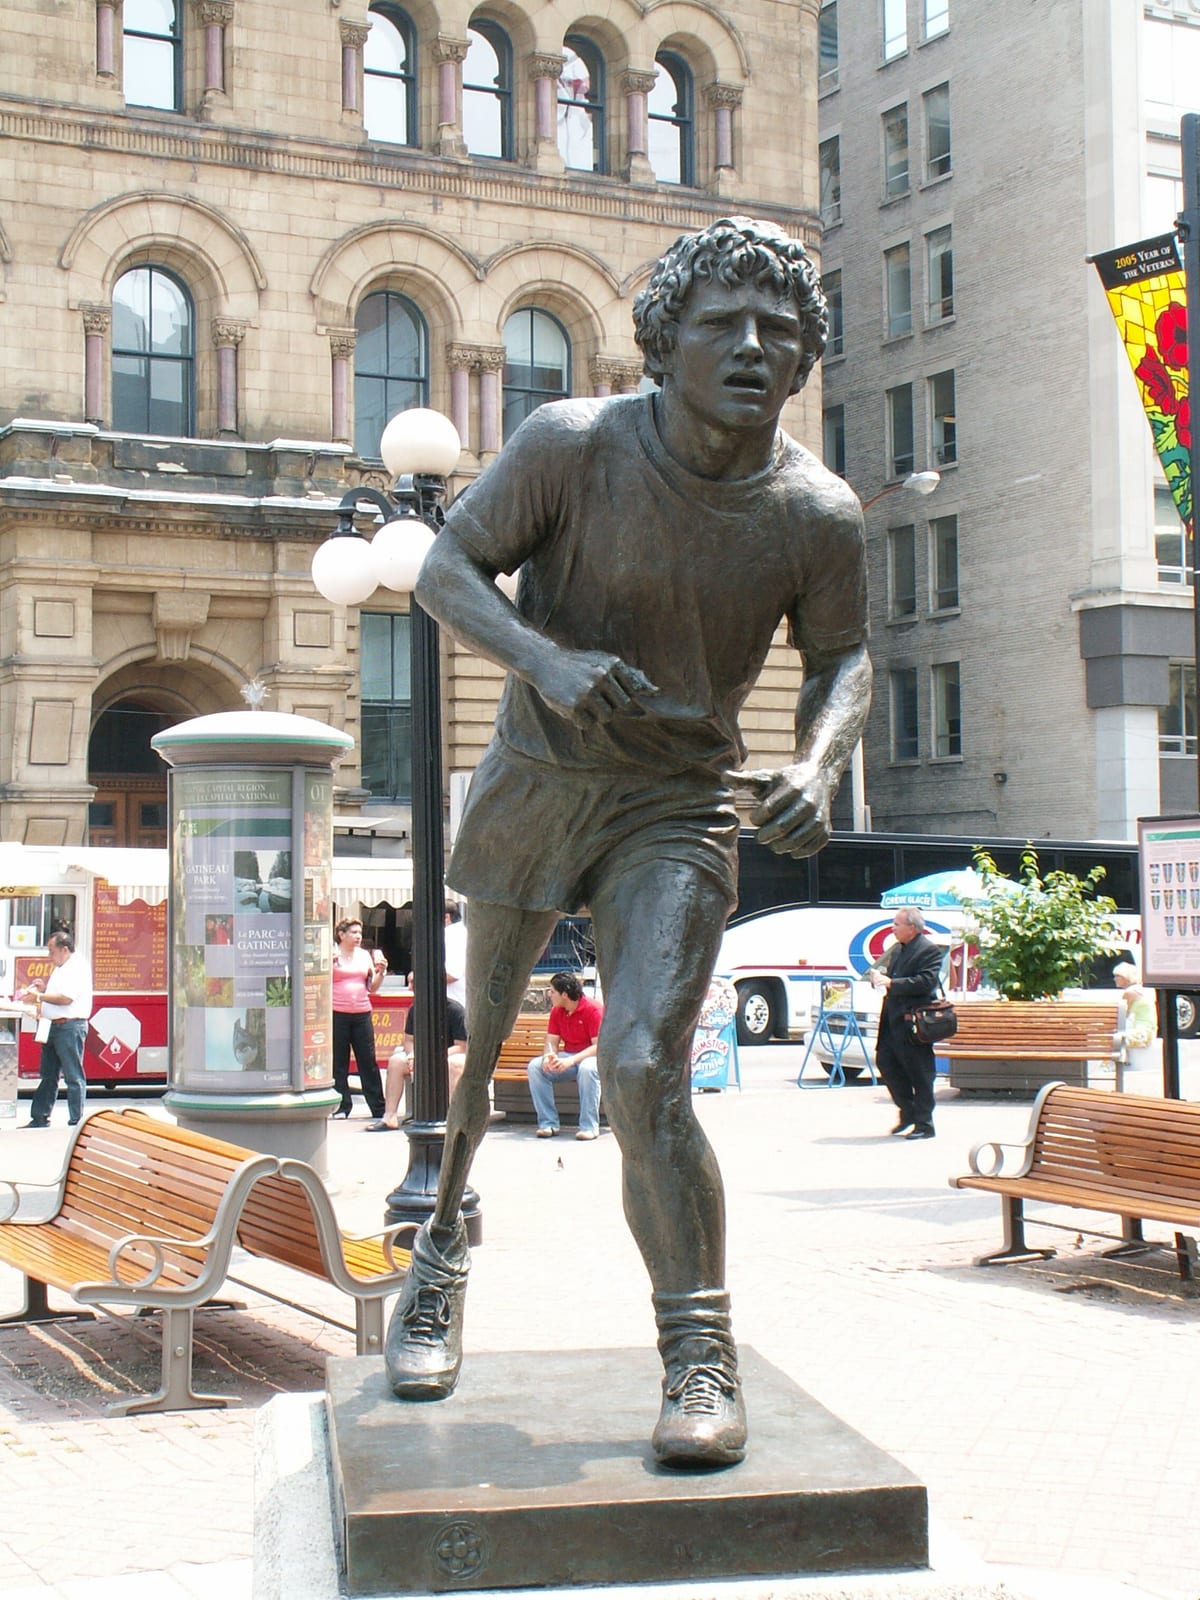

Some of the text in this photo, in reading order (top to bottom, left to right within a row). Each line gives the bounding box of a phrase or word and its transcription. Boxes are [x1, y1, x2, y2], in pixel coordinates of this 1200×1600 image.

[1115, 254, 1137, 269] 2005
[237, 783, 266, 792] REGION
[186, 864, 229, 874] GATINEAU
[193, 875, 216, 885] PARK
[248, 929, 276, 939] PARC
[238, 940, 291, 950] GATINEAU
[27, 963, 55, 977] COL
[374, 1033, 403, 1047] AGES
